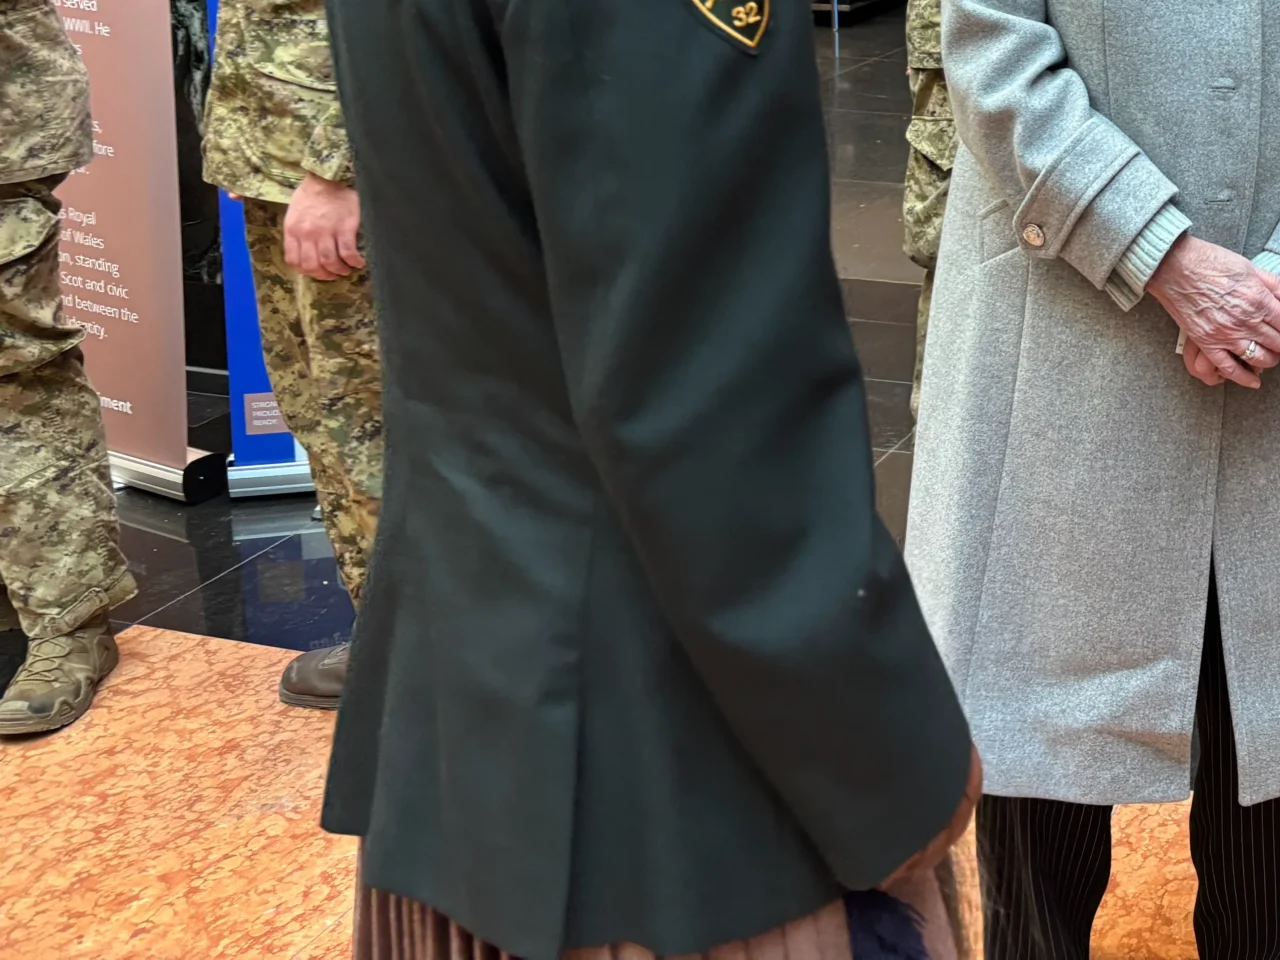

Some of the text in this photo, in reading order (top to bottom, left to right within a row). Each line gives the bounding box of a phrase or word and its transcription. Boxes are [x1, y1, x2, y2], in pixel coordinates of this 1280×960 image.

[731, 1, 762, 27] 32
[94, 21, 111, 37] He
[68, 207, 96, 227] Royal
[72, 230, 105, 249] Wales
[75, 254, 120, 278] standing
[60, 271, 129, 299] Scot and civic
[75, 295, 119, 319] between
[121, 308, 139, 323] the
